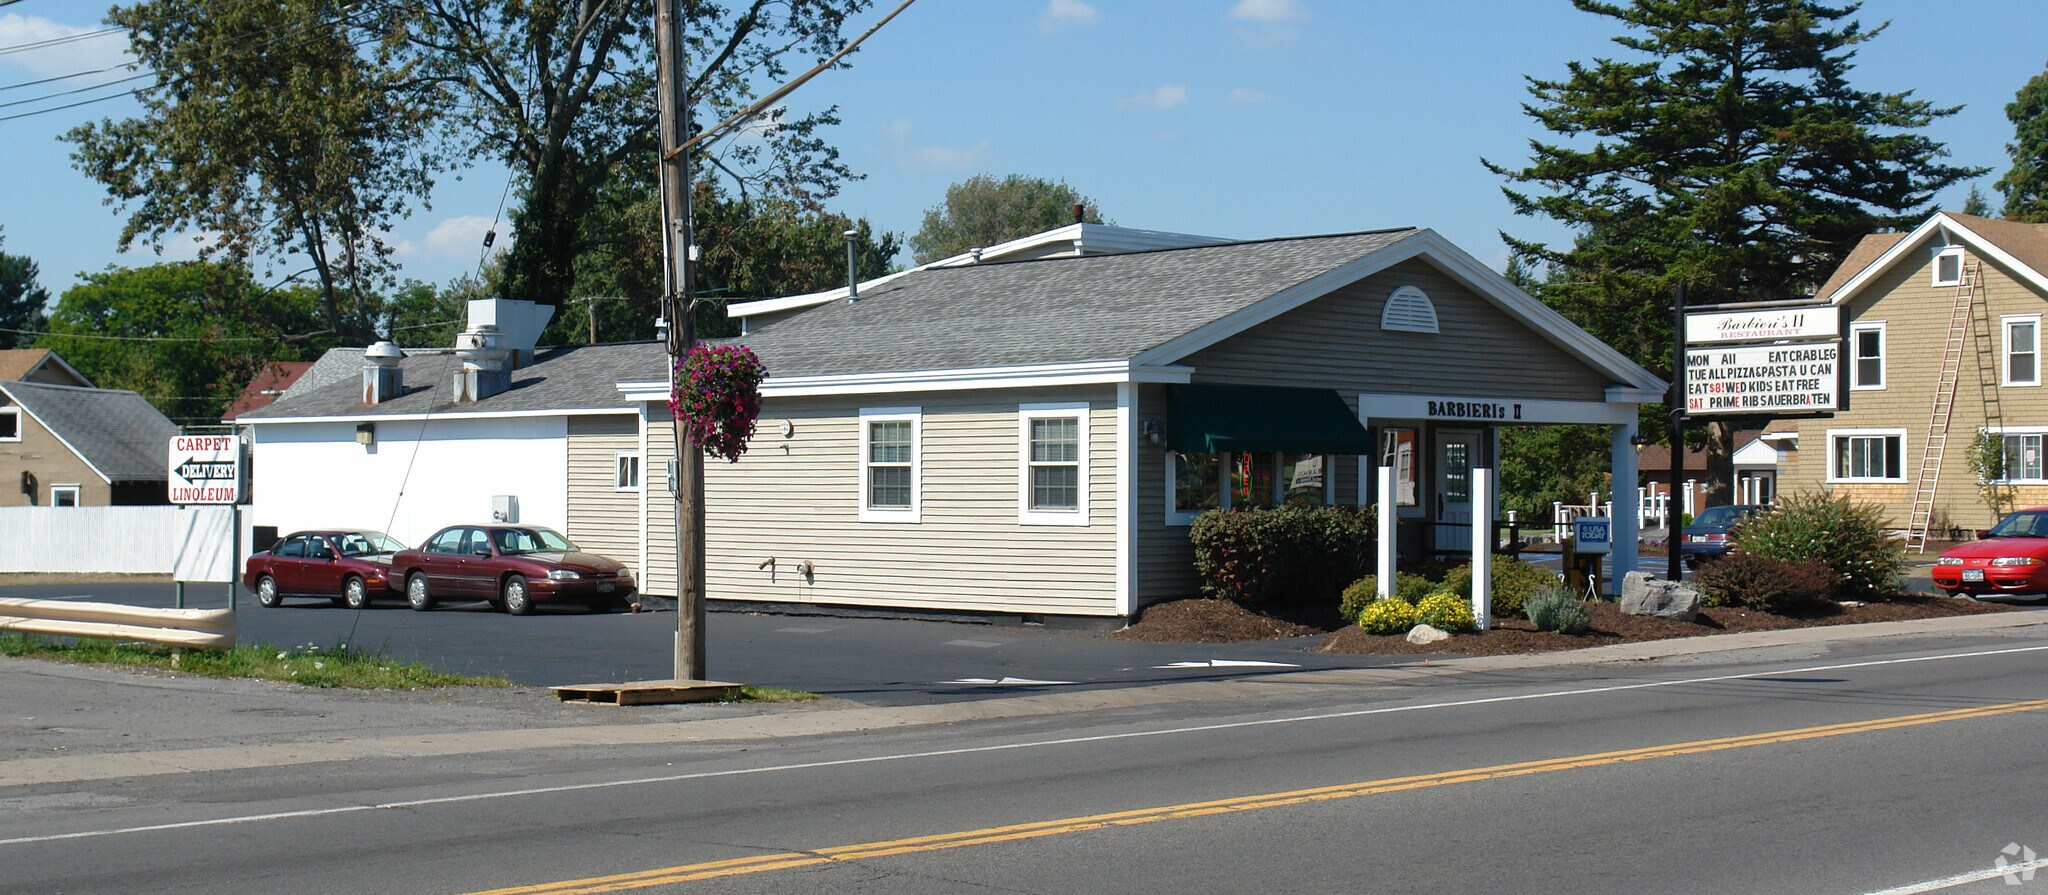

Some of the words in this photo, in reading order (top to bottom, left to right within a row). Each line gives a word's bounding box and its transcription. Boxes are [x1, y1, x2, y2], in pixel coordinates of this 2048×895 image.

[1717, 315, 1788, 330] Barbieri's
[1720, 328, 1802, 339] RESTAURANT
[1687, 354, 1710, 366] MON
[1768, 351, 1788, 363] EAT
[1789, 349, 1817, 362] CRAB
[1818, 348, 1837, 361] LEG
[1689, 369, 1706, 381] TUE
[1708, 368, 1726, 380] ALL
[1800, 364, 1807, 376] U
[1810, 363, 1832, 376] CAN
[1689, 383, 1708, 395] EAT
[1725, 381, 1747, 393] WED
[1748, 381, 1773, 392] KIDS
[1775, 380, 1795, 392] EAT
[1796, 379, 1820, 391] FREE
[1689, 398, 1703, 410] SAT
[1709, 396, 1740, 408] PRIME
[1742, 395, 1759, 407] RIB
[1760, 393, 1830, 406] SAUERBRATEN
[1513, 403, 1522, 420] II
[177, 437, 231, 451] CARPET
[181, 464, 235, 478] DELIVERY
[173, 487, 235, 501] LINOLEUM
[1589, 525, 1605, 533] USA
